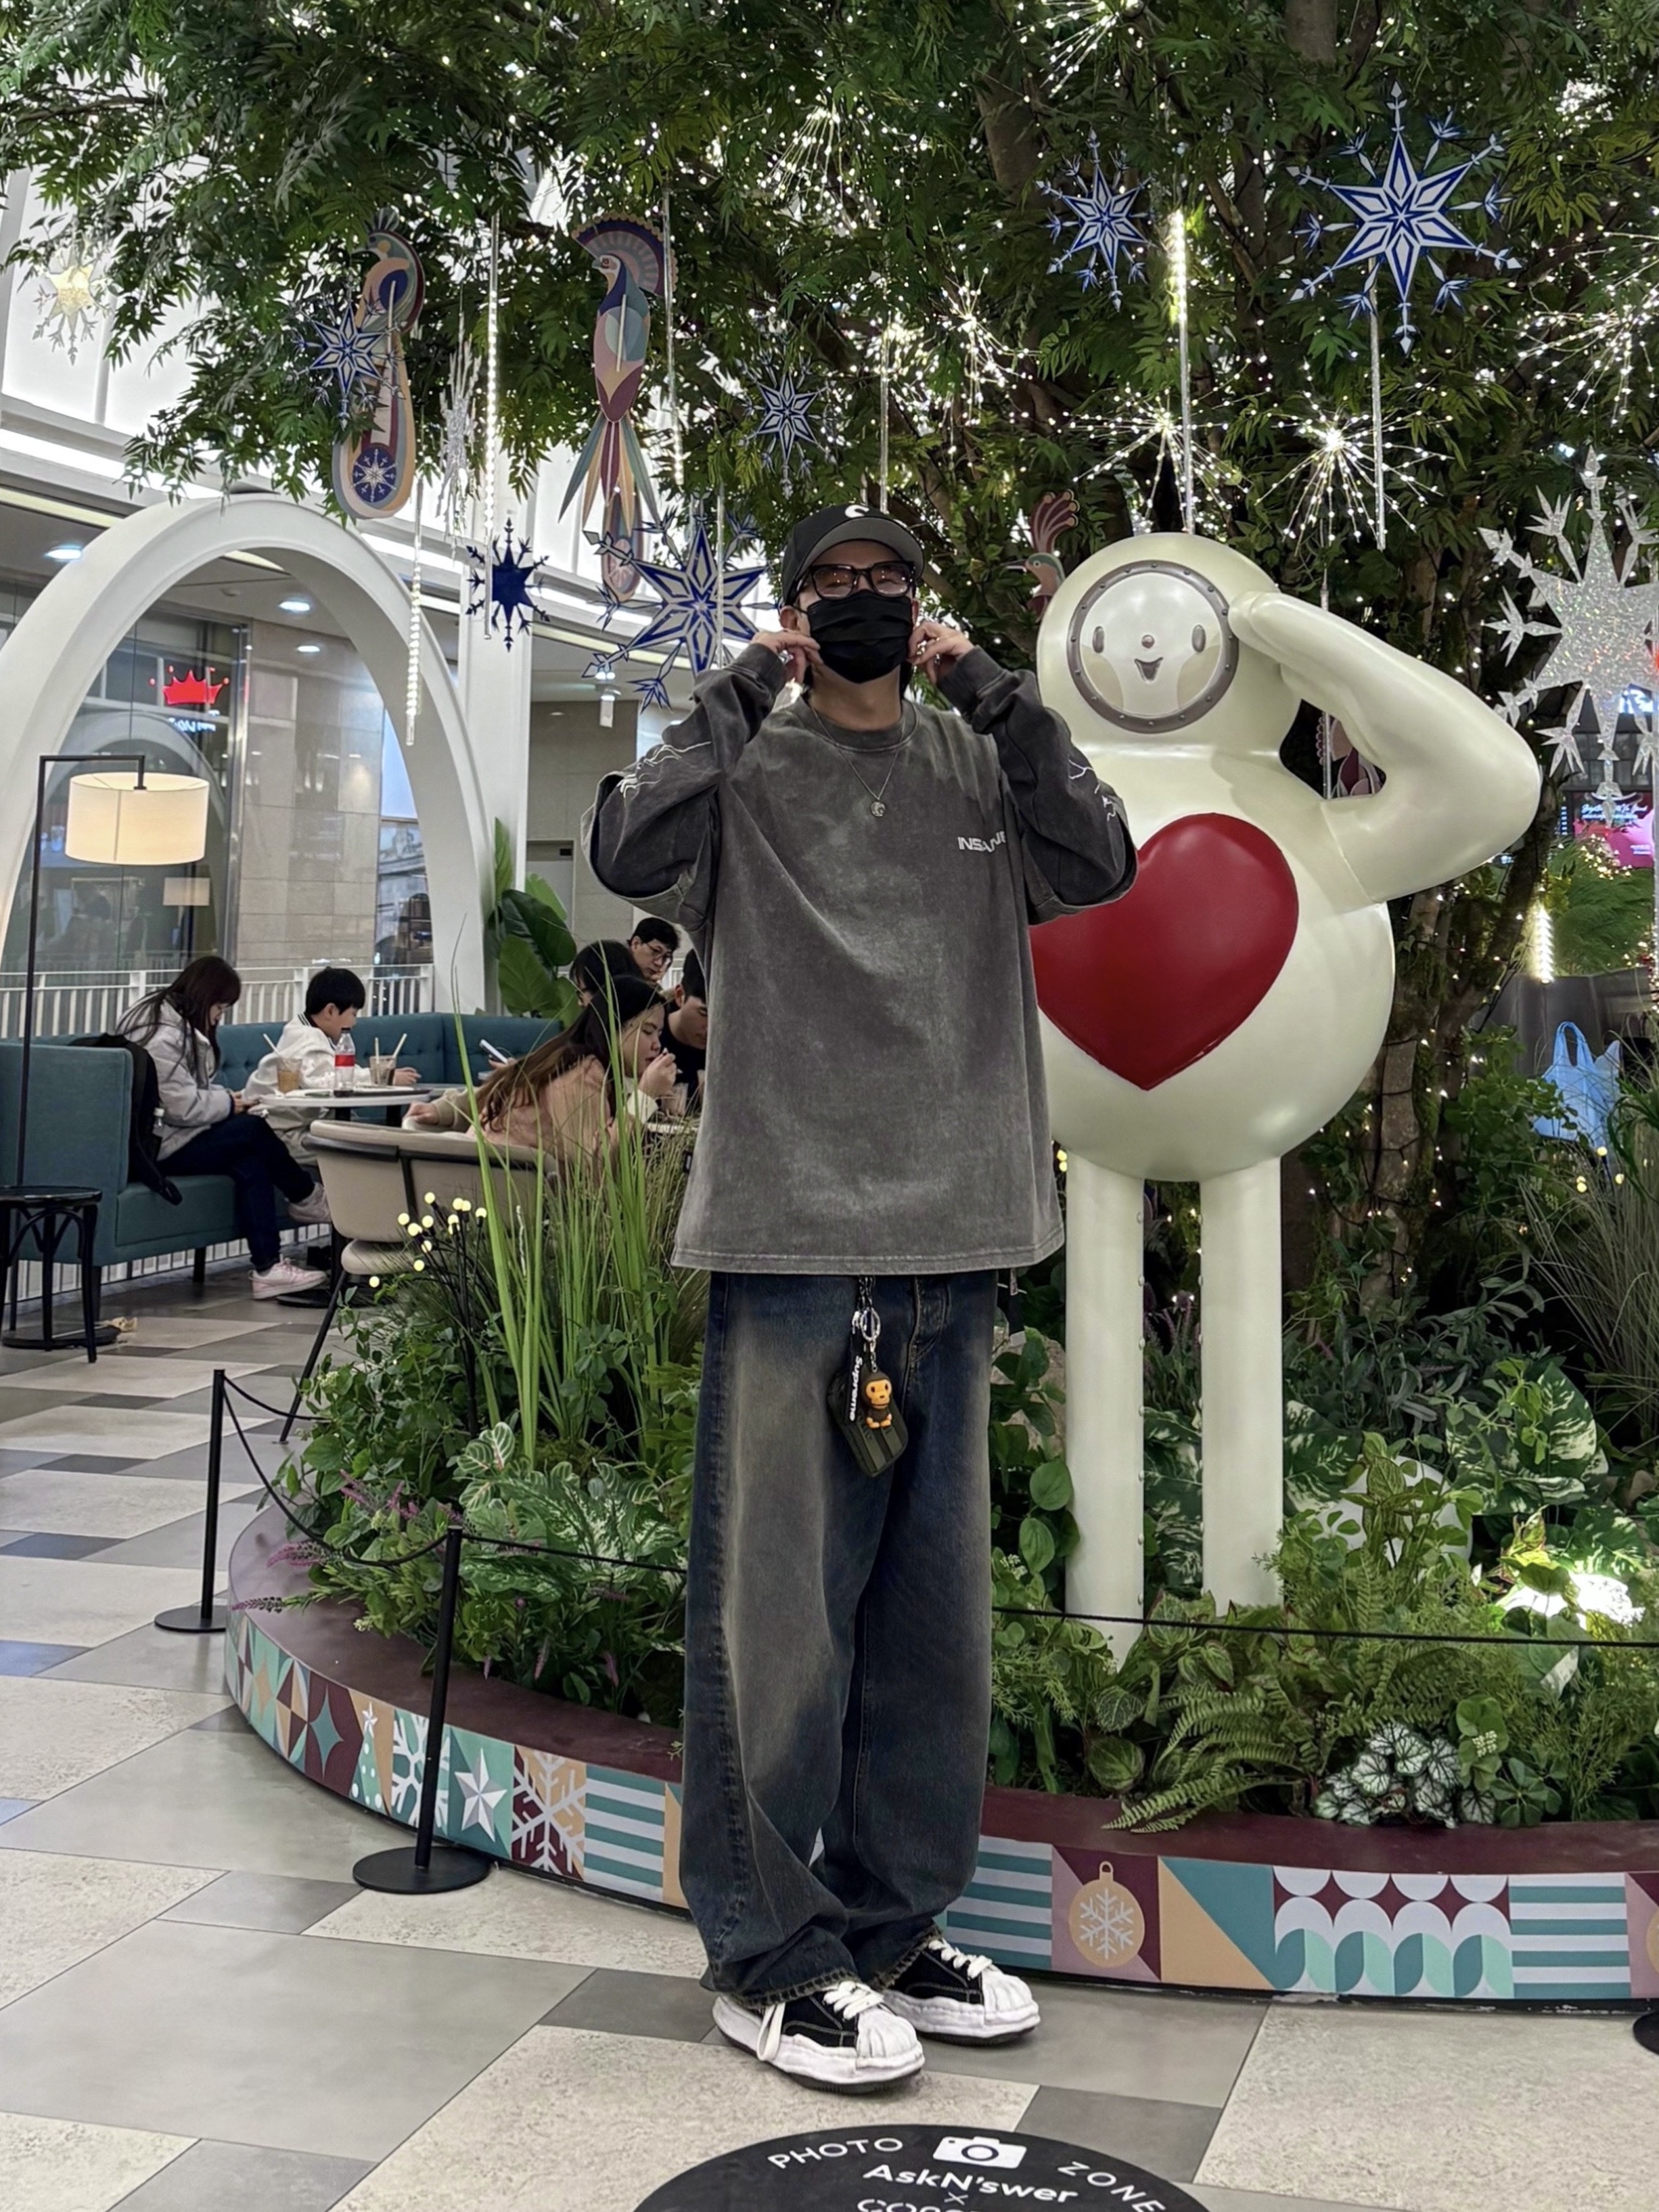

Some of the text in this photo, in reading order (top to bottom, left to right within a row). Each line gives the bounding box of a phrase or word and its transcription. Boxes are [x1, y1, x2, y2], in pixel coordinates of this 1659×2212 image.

[767, 2138, 1166, 2212] PHOTO ZONE
[863, 2164, 1078, 2203] AskN'swer
